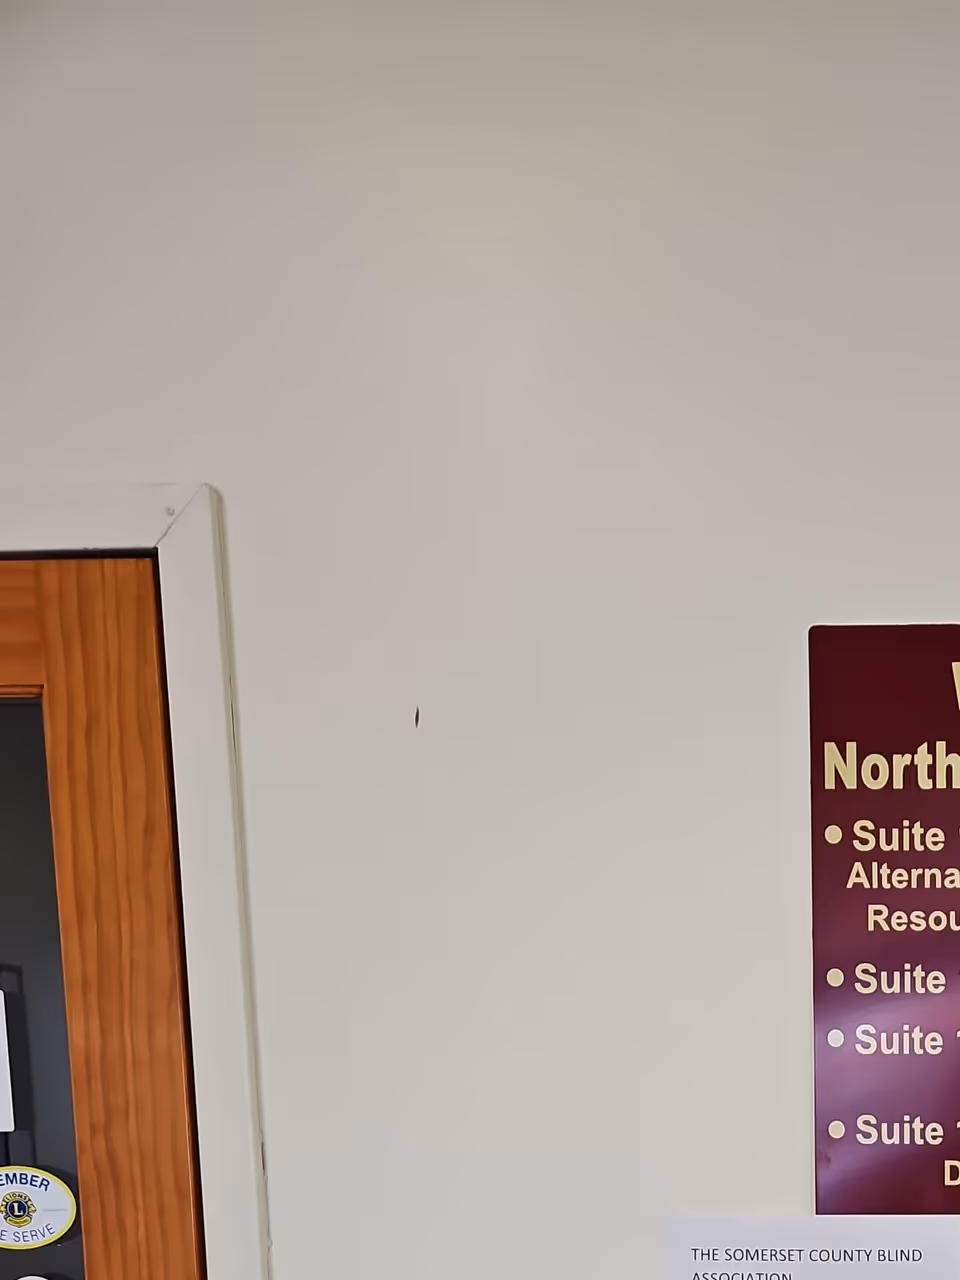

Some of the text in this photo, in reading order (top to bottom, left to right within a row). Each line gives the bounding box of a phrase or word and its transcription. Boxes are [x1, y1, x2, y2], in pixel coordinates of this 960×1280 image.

[853, 819, 945, 851] Suite
[854, 963, 945, 993] Suite
[855, 1024, 943, 1055] Suite
[856, 1115, 943, 1145] Suite
[13, 1223, 56, 1243] SERVE
[691, 1249, 923, 1263] THE SOMERSET COUNTY BLIND
